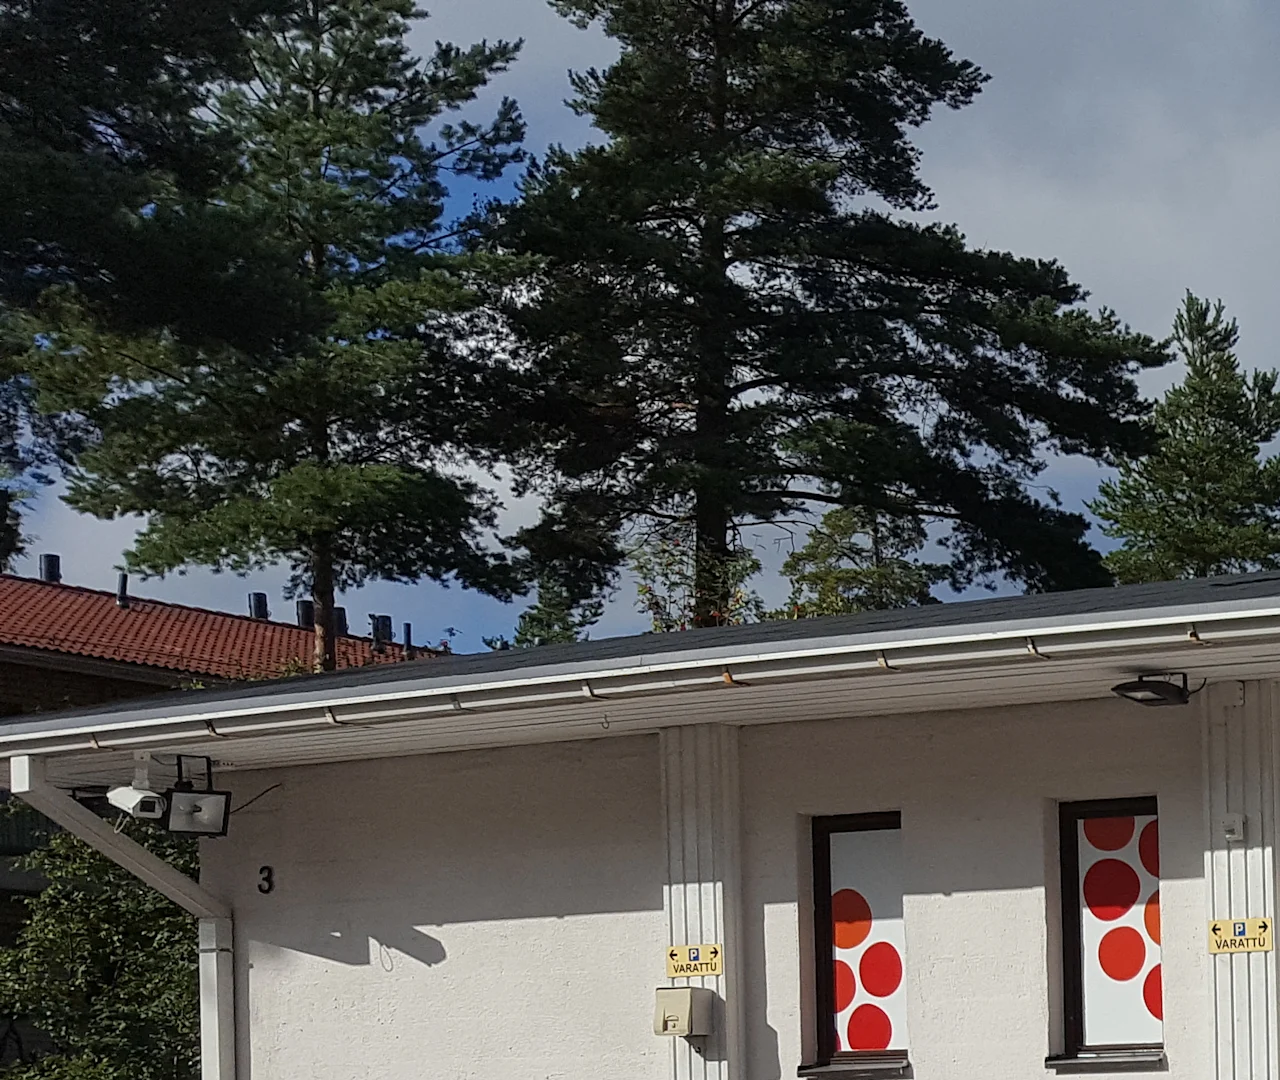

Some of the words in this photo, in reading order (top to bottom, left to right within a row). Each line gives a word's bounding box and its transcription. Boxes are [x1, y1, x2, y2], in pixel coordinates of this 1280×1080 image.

[258, 865, 275, 895] 3
[1234, 923, 1244, 936] P
[1215, 937, 1266, 949] VARATTU
[689, 949, 698, 961] P
[672, 962, 717, 973] VARATTU
